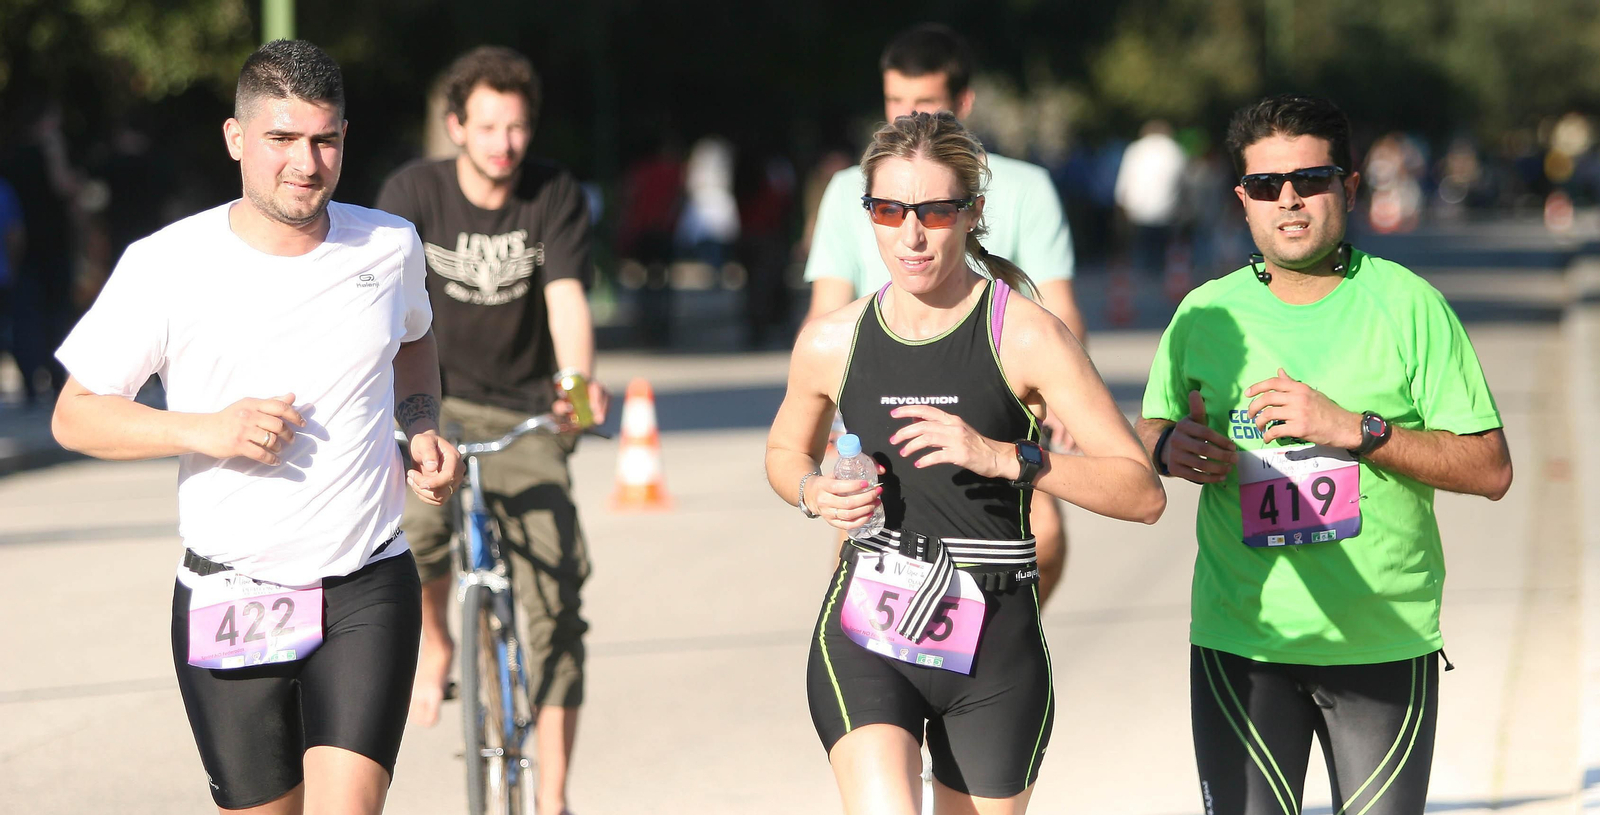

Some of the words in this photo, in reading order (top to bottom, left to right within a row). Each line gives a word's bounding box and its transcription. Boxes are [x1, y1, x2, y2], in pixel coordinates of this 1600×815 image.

[880, 395, 959, 405] REVOLUTION
[1259, 476, 1336, 525] 419
[894, 561, 906, 576] IV
[215, 597, 295, 647] 422
[869, 590, 959, 642] 55
